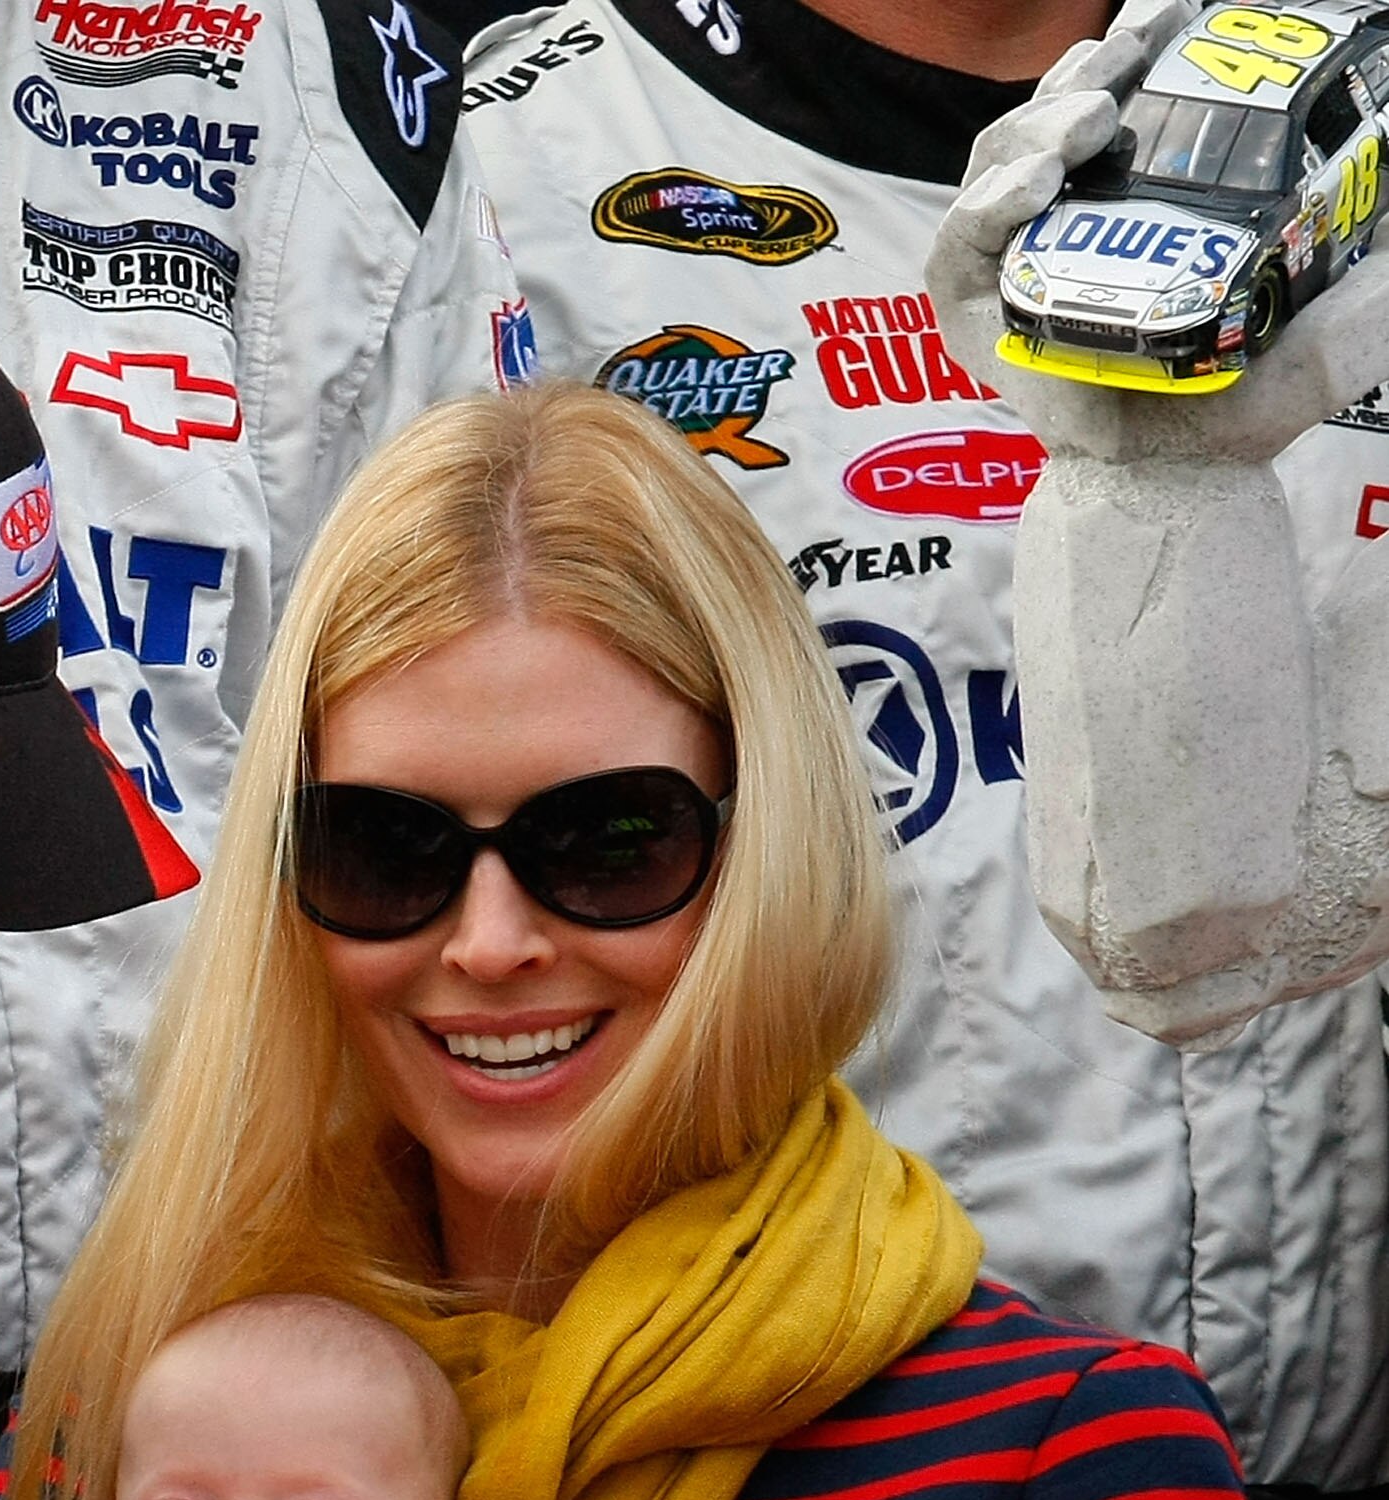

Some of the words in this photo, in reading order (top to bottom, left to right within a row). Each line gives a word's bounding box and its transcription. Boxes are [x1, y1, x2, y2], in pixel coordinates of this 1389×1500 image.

[36, 0, 262, 43] Hendrick
[67, 32, 245, 56] MOTORSPORTS
[70, 112, 260, 163] KOBALT
[91, 152, 237, 209] TOOLS
[659, 185, 736, 207] NASCAR
[1331, 134, 1380, 244] 48
[25, 207, 137, 244] CERTIFIED
[682, 208, 759, 231] Sprint
[24, 231, 96, 283] TOP
[703, 237, 744, 251] CUP
[747, 236, 815, 255] SERIES
[1021, 210, 1239, 279] LOWE'S
[1047, 314, 1138, 337] IMPALA
[608, 353, 786, 393] QUAKER
[816, 331, 1003, 411] GUA
